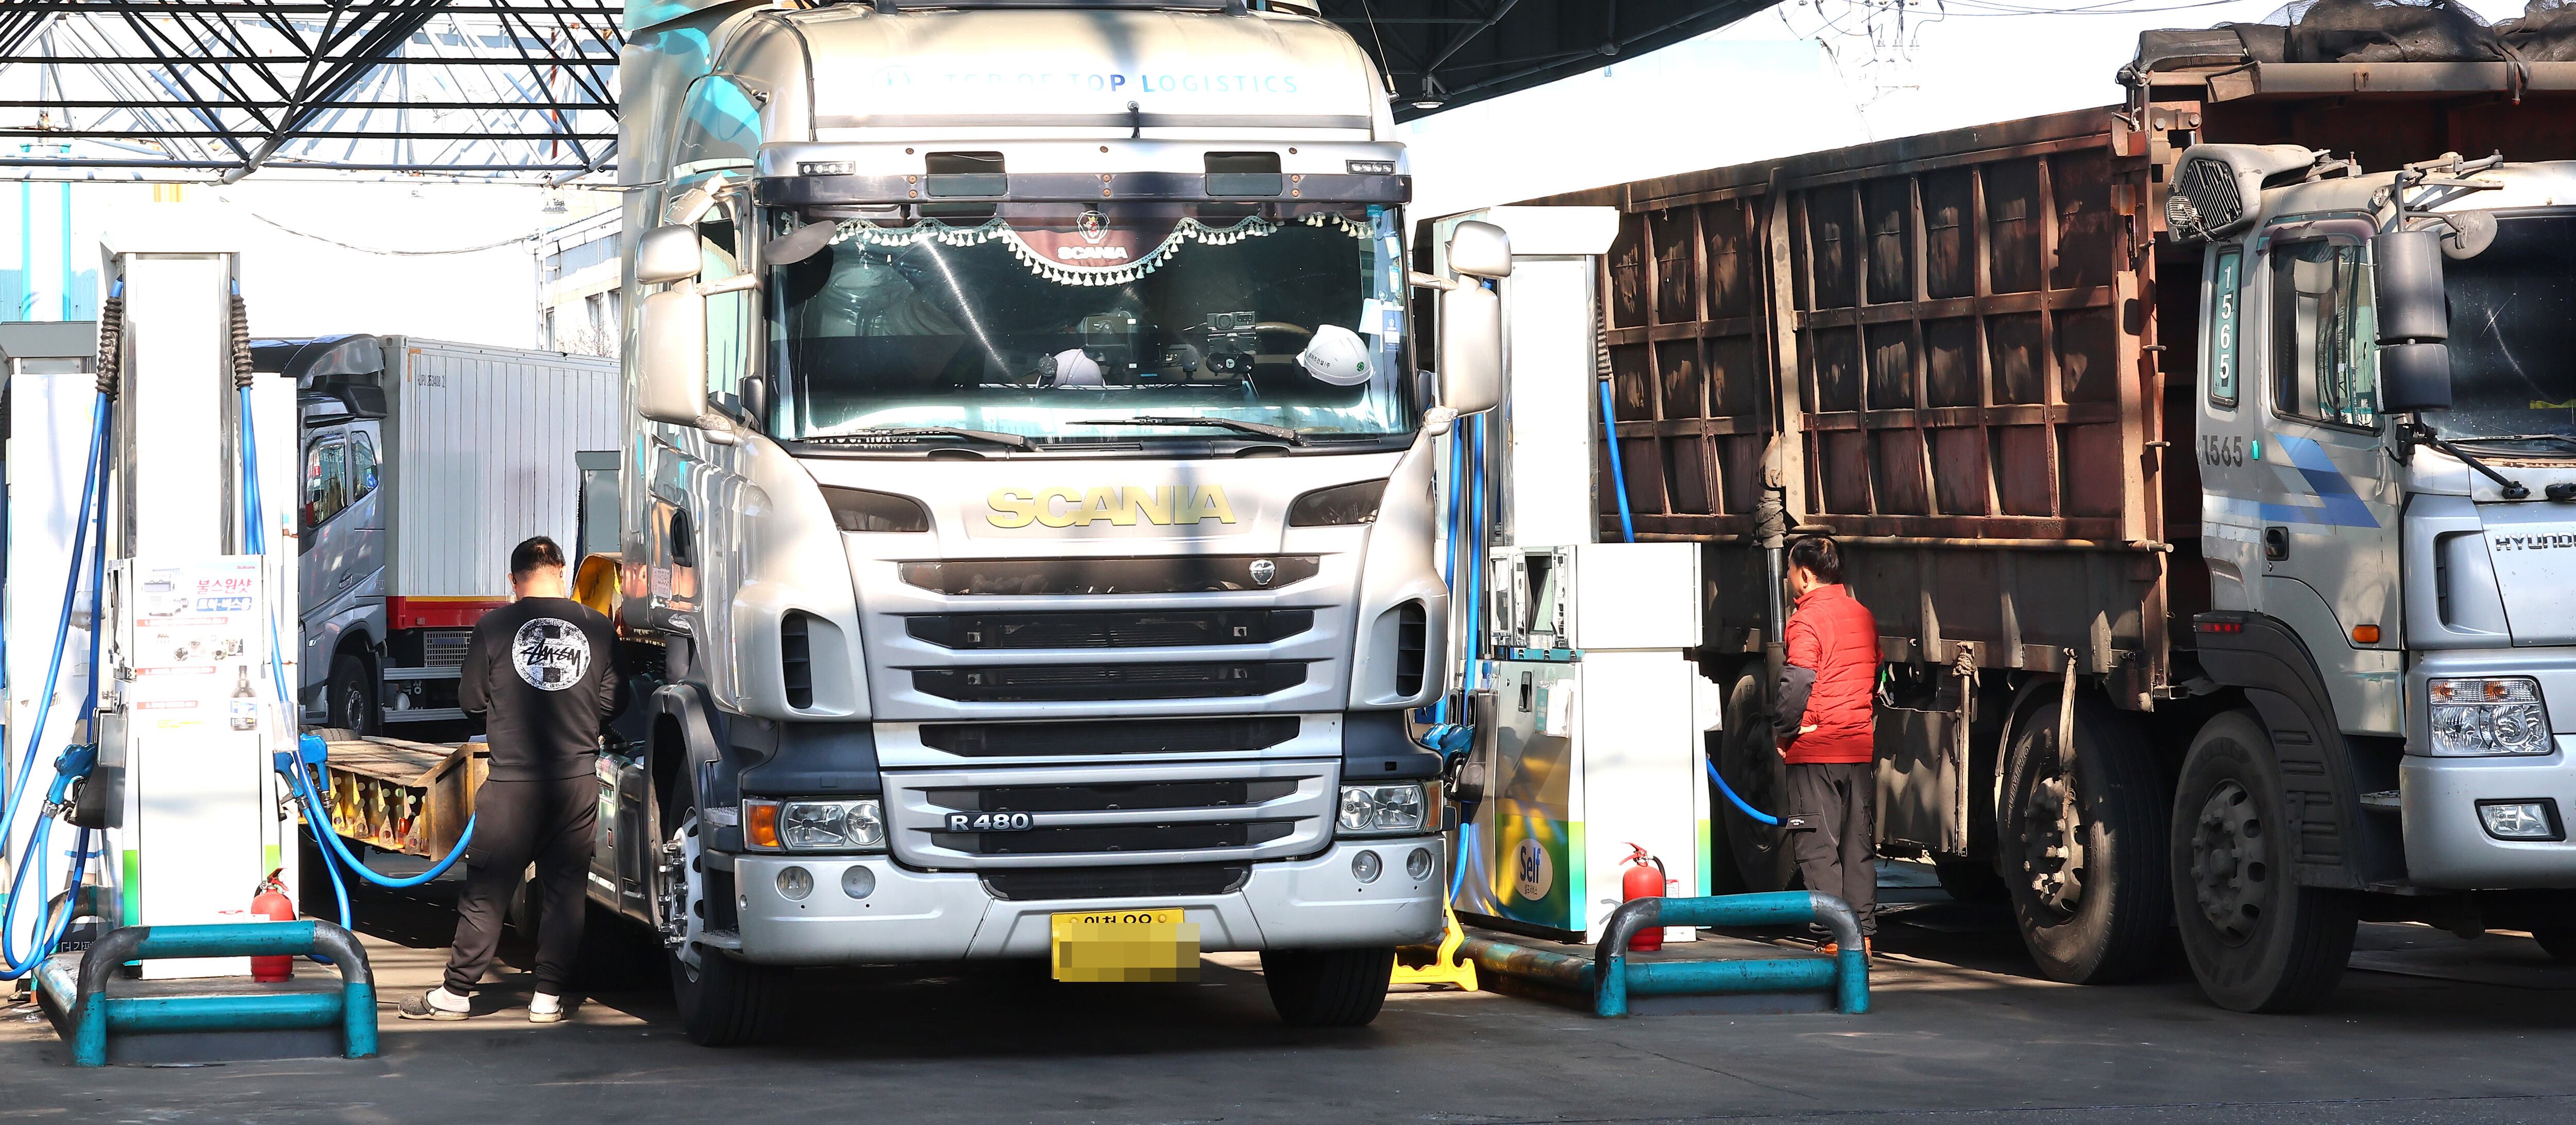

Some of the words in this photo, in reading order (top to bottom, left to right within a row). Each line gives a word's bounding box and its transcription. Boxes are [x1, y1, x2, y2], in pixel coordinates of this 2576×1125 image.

[1067, 74, 1126, 92] TOP
[1142, 74, 1297, 93] LOGISTICS
[1058, 246, 1129, 259] SCANIA
[2219, 265, 2232, 379] 1565
[2202, 435, 2242, 467] 1565
[986, 484, 1236, 529] SCANIA
[2495, 531, 2576, 551] HYUND
[197, 578, 252, 595] 불스원샷
[951, 815, 969, 831] R
[973, 813, 1029, 830] 480
[1520, 846, 1541, 884] Self
